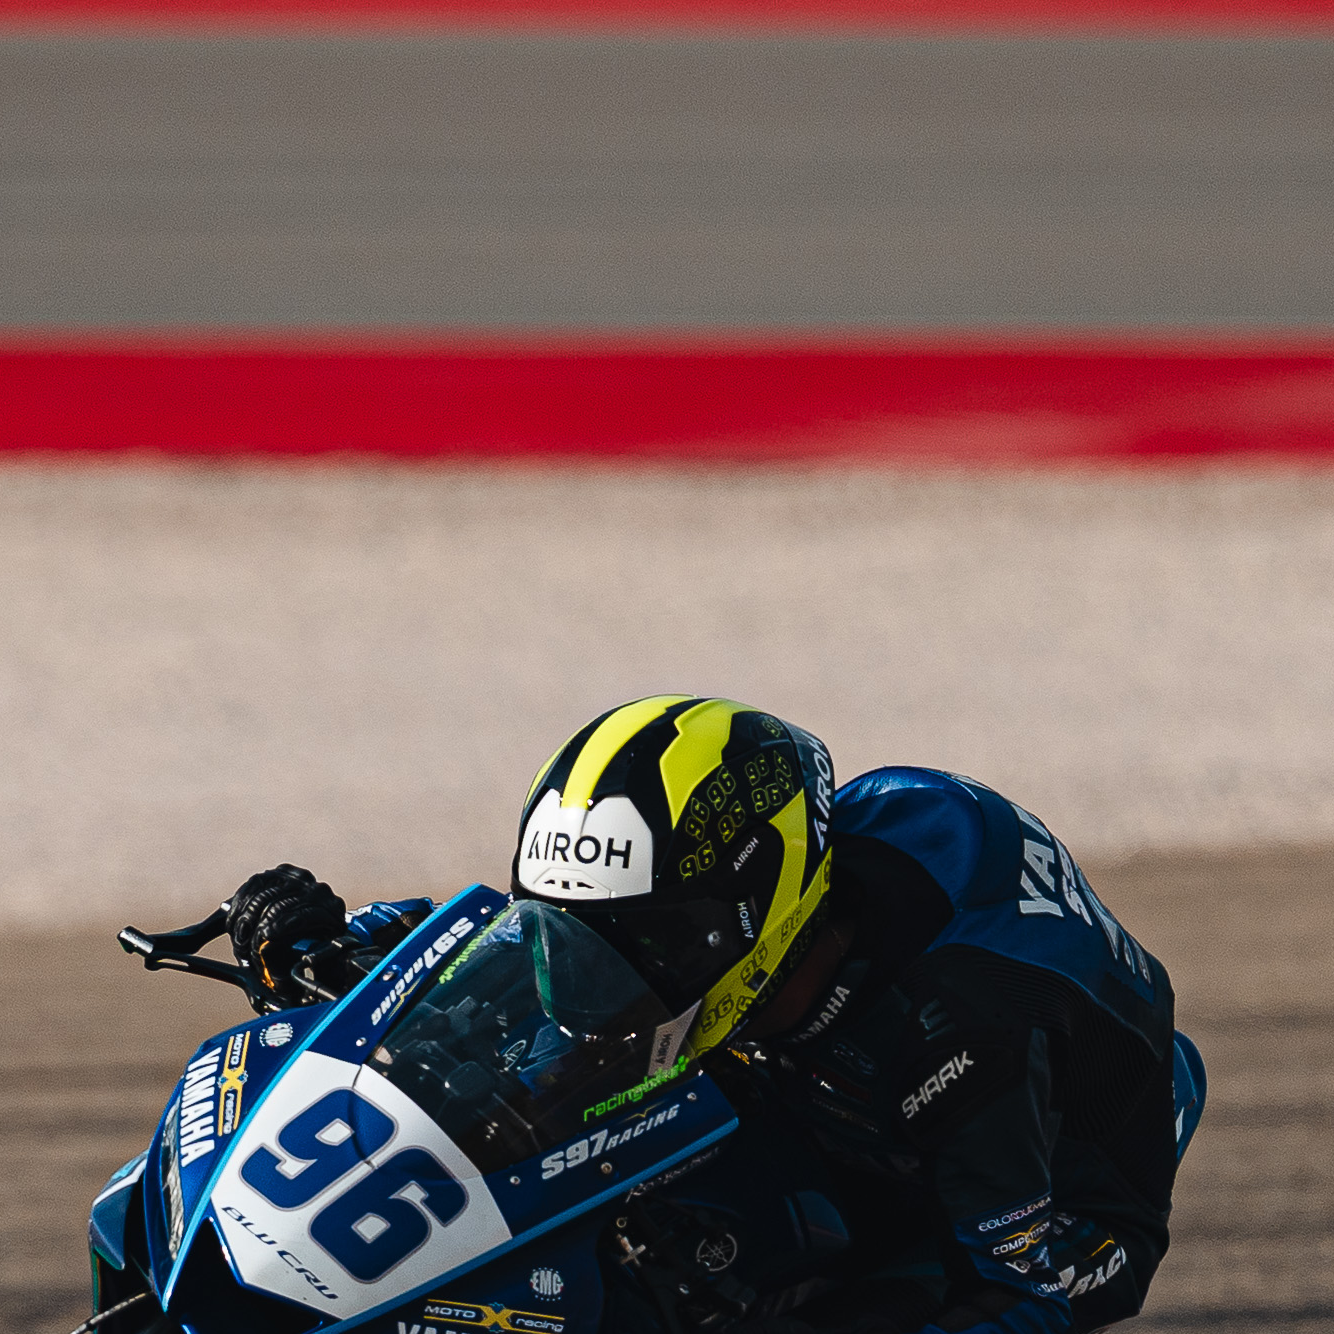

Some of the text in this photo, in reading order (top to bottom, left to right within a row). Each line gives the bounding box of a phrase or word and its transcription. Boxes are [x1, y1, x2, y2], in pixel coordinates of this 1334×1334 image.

[707, 765, 737, 812] 96
[751, 783, 784, 813] 96
[527, 831, 633, 870] AIROH
[733, 837, 760, 872] AIROH
[737, 902, 755, 939] AIROH
[901, 1050, 974, 1120] SHARK
[180, 1047, 222, 1168] YAMAHA
[541, 1129, 609, 1180] S97
[239, 1087, 470, 1286] 96
[221, 1205, 339, 1301] BLU CRU
[531, 1270, 564, 1296] EMG
[424, 1305, 477, 1319] MOTO
[515, 1317, 564, 1333] racing
